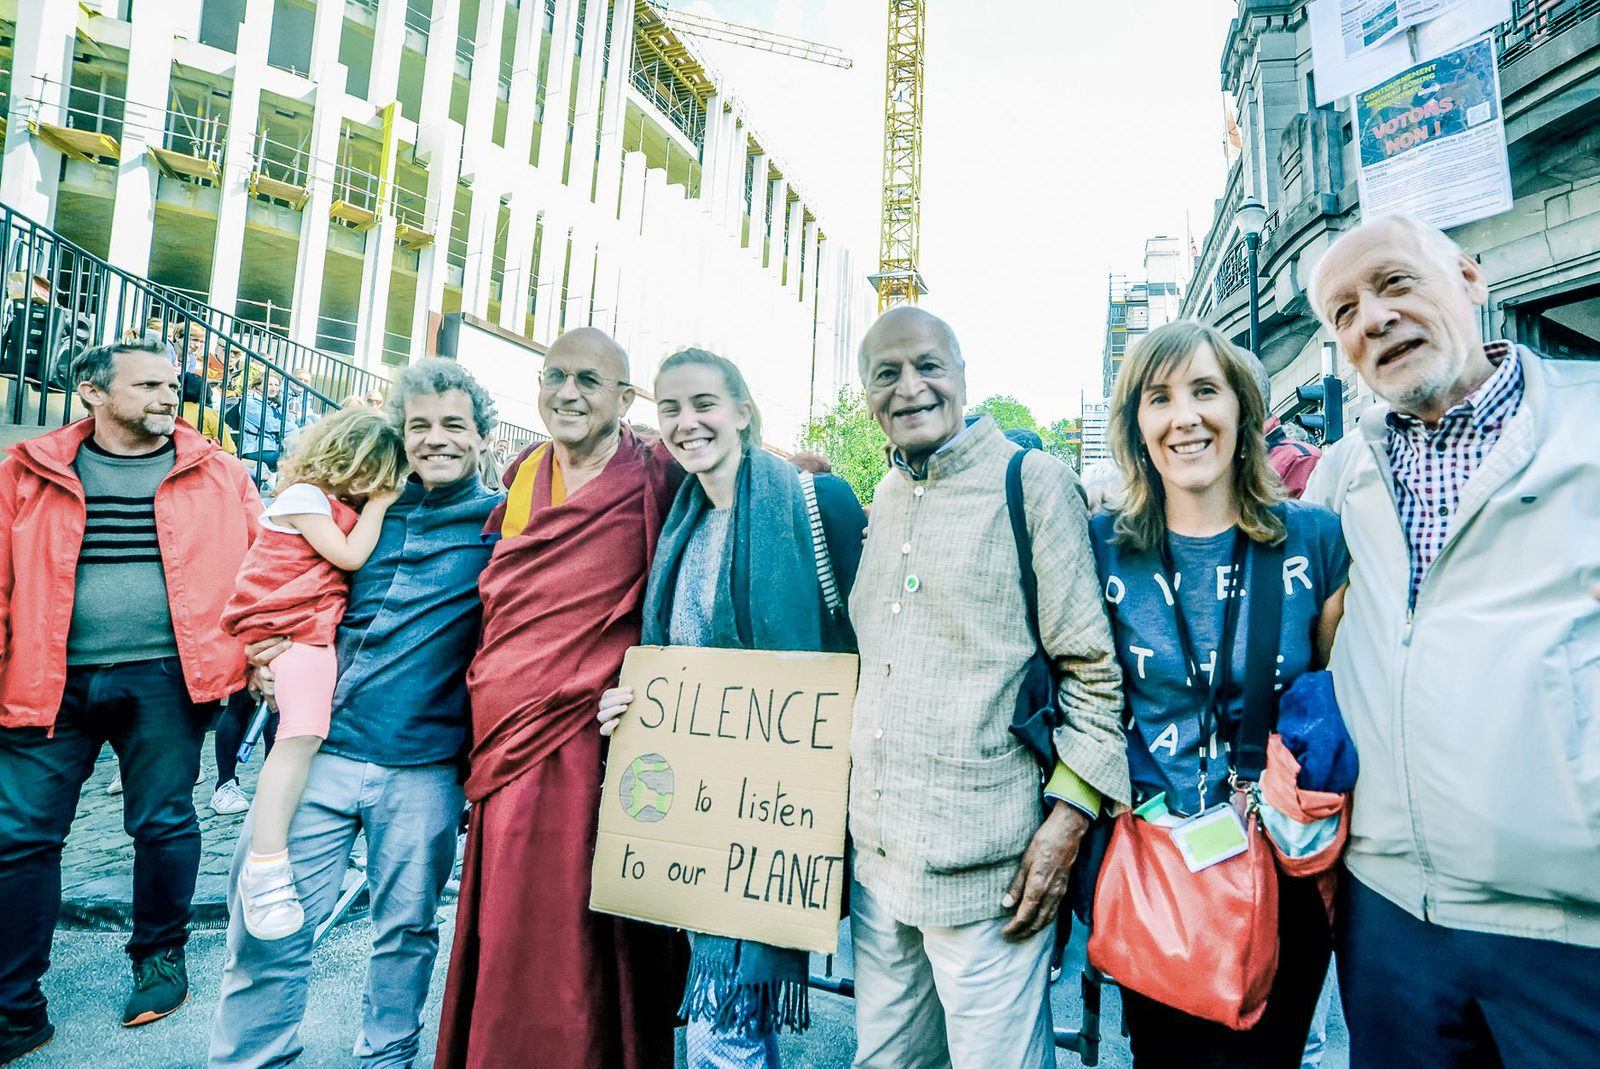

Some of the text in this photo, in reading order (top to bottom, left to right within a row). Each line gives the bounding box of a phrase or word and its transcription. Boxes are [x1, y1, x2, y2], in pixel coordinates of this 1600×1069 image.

[1363, 63, 1437, 102] CONTOURNEMENT
[1372, 97, 1453, 139] VOTONS
[1386, 120, 1441, 155] NON !
[694, 777, 814, 829] to listen
[621, 842, 844, 910] to our PLANET
